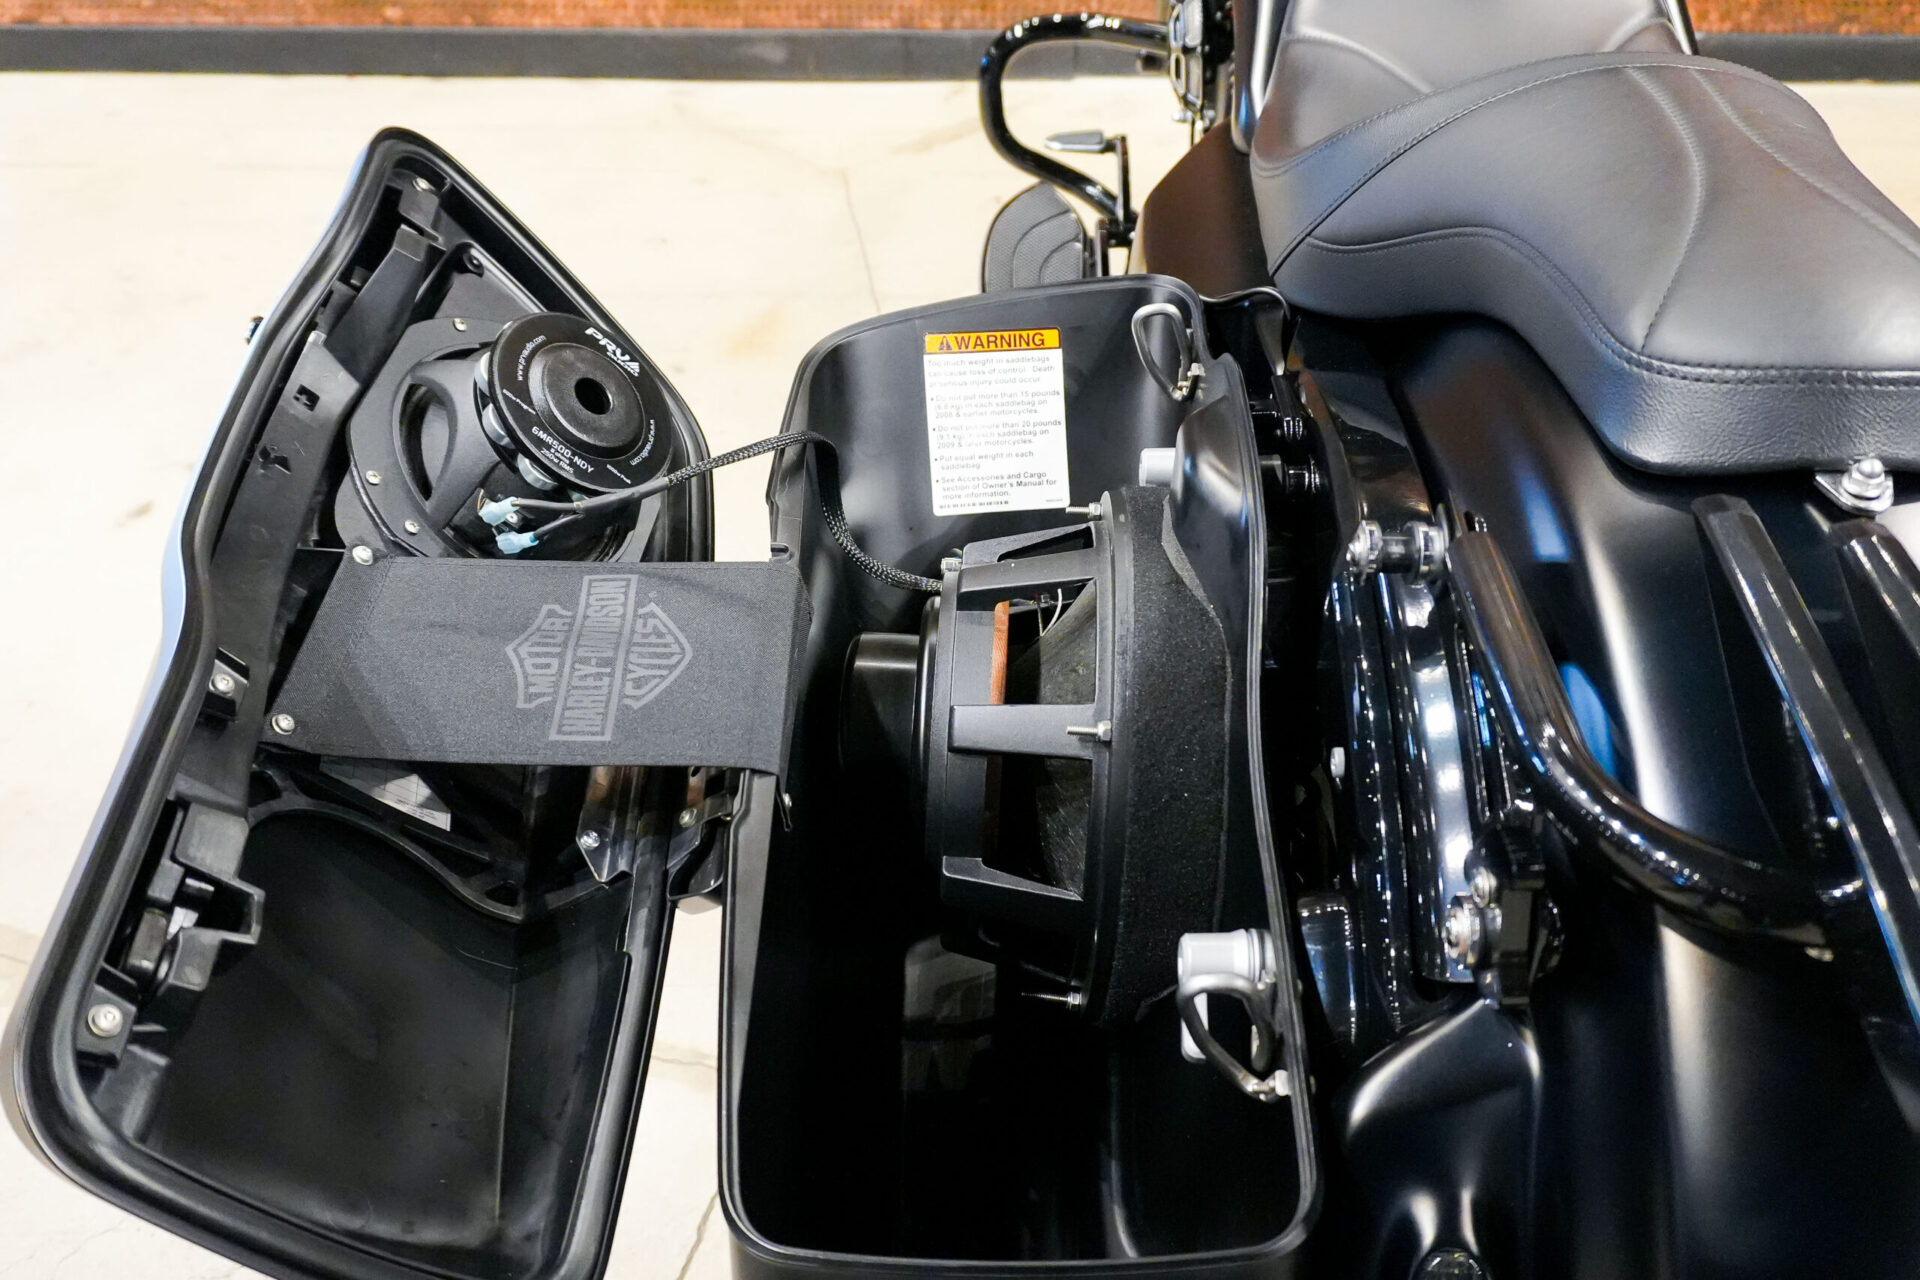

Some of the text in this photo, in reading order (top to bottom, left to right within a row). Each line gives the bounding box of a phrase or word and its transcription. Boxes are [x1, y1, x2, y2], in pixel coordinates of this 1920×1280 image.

[954, 332, 1045, 350] WARNING
[968, 358, 993, 367] weight
[1006, 356, 1050, 364] saddlebags
[970, 378, 992, 386] injury
[978, 392, 998, 400] more
[1032, 390, 1060, 398] pounds
[996, 399, 1036, 408] saddlebag
[1032, 420, 1062, 428] pounds
[998, 428, 1038, 438] saddlebag
[1040, 428, 1050, 436] on
[978, 452, 1004, 461] weight
[1015, 450, 1034, 458] each
[560, 462, 574, 474] RMS
[942, 471, 1046, 484] See Accessories and Cargo
[942, 484, 970, 492] section
[982, 481, 1014, 490] Owner's
[1016, 480, 1044, 488] Manual
[964, 490, 1011, 498] information.
[518, 617, 572, 693] MOTOR
[561, 580, 627, 732] HARLEY-DAVIDSON
[623, 617, 684, 696] CYCLES
